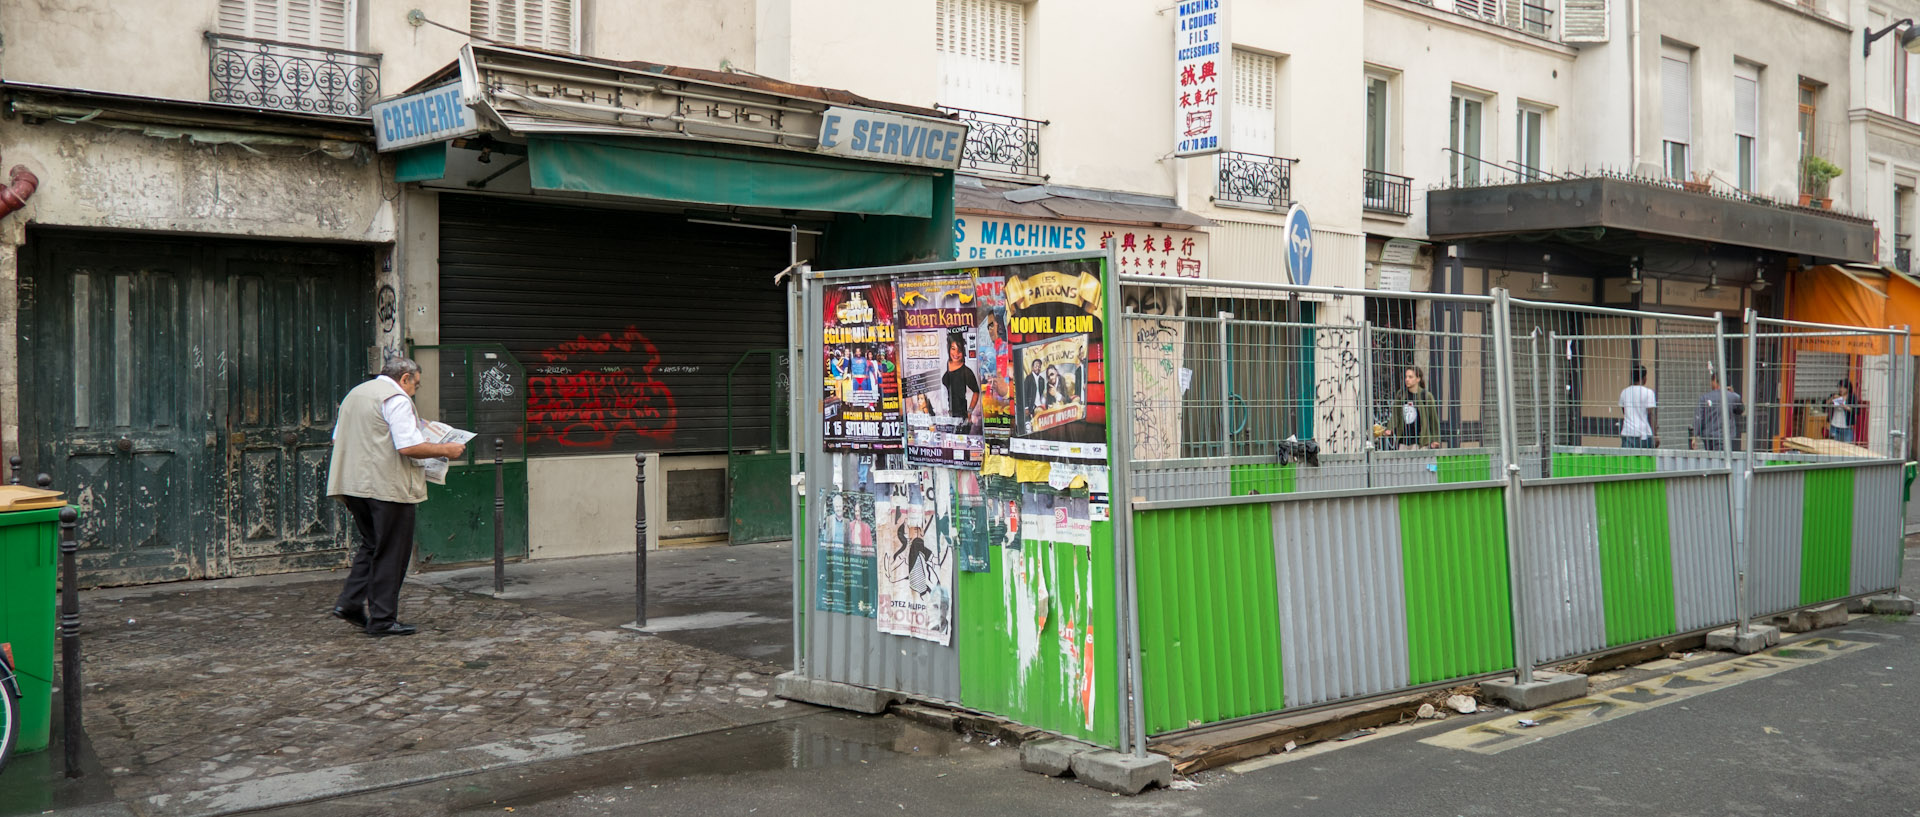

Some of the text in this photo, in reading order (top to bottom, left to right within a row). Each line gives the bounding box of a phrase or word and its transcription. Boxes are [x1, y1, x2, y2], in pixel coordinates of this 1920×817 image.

[1180, 0, 1219, 17] MACHINES
[1181, 12, 1217, 31] A COUDRE
[1189, 29, 1208, 45] FILS
[1178, 42, 1219, 61] ACCESSOIRES
[1180, 61, 1217, 87] 誠興
[1179, 88, 1218, 109] 衣車行
[382, 89, 464, 142] CREMERIE
[850, 119, 959, 162] SERVICE
[981, 220, 1086, 250] MACHINES
[969, 247, 987, 259] DE
[1042, 276, 1056, 284] LES
[1028, 285, 1078, 301] PATRONS
[1055, 315, 1095, 333] ALBUM
[833, 421, 842, 436] 15
[881, 421, 900, 437] 2012
